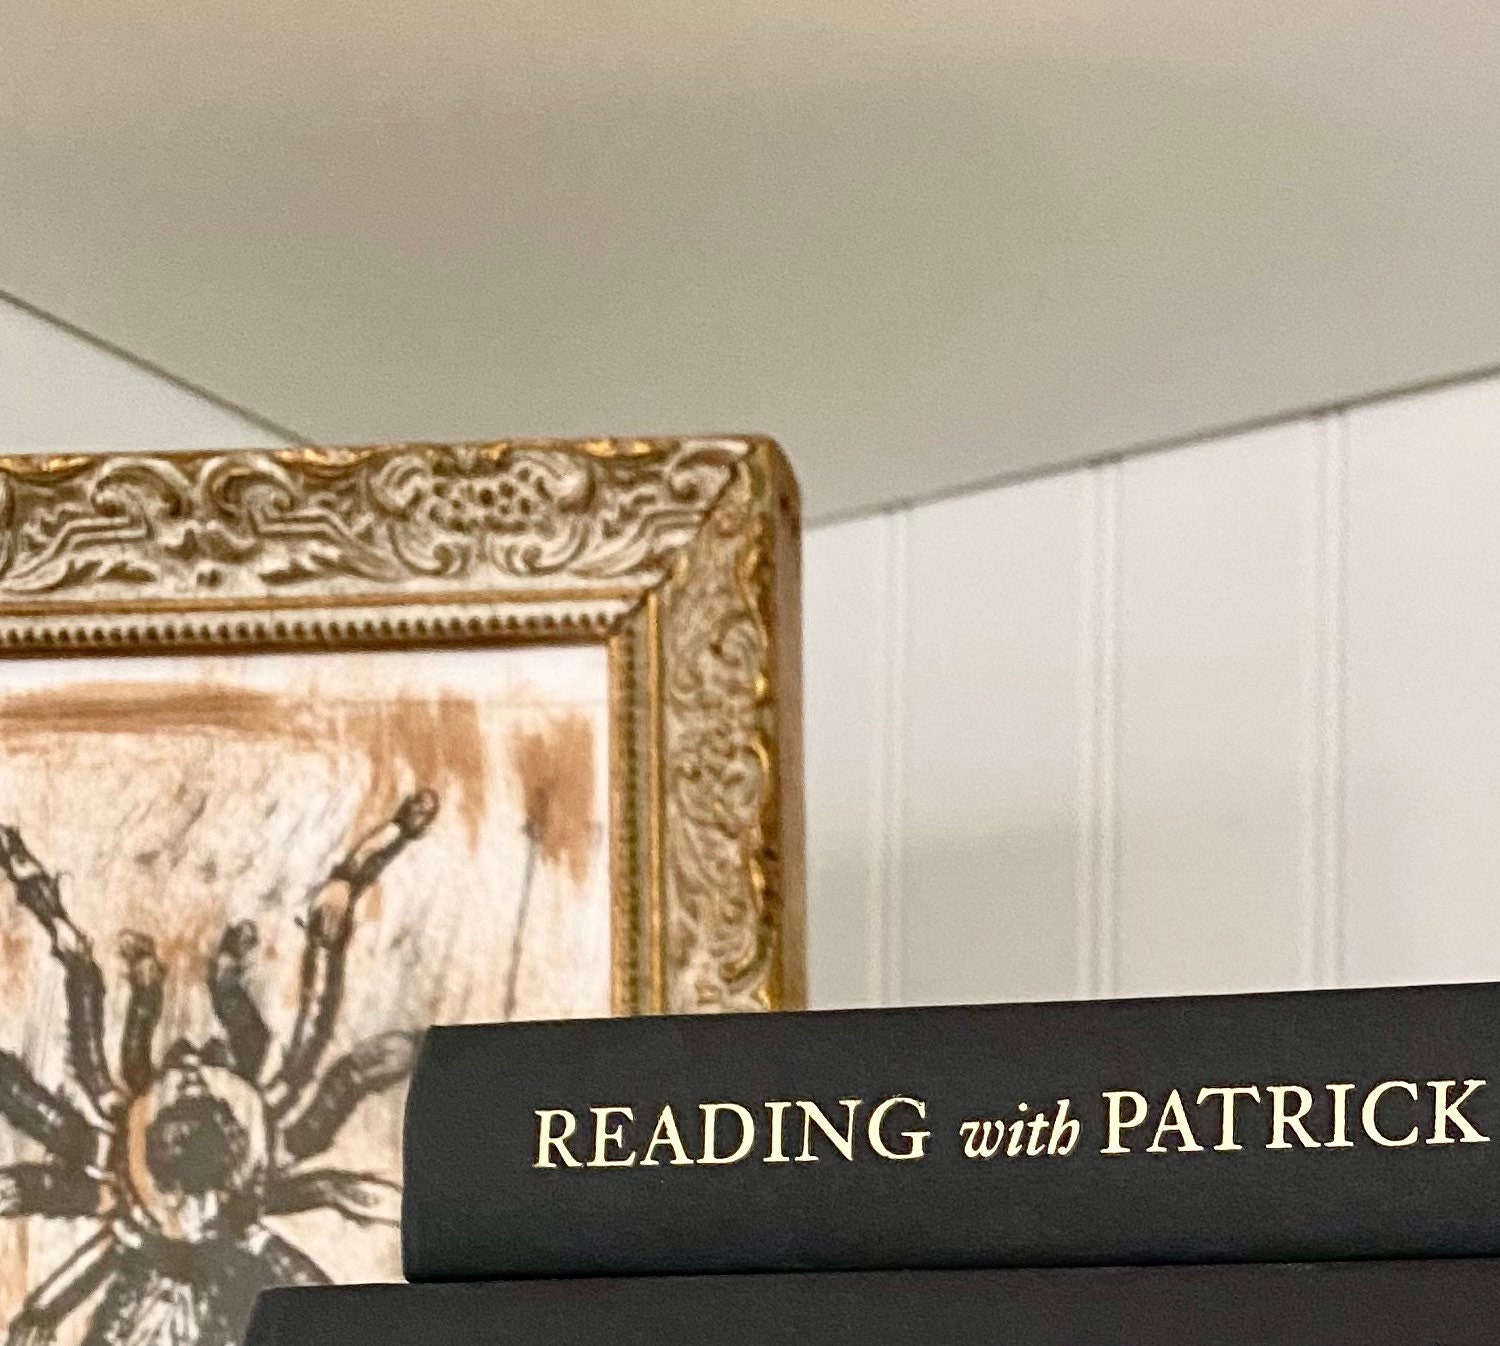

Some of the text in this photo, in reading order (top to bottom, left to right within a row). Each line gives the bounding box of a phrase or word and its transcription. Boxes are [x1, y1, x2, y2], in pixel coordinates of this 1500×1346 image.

[532, 1079, 1490, 1168] READING with PATRICK
